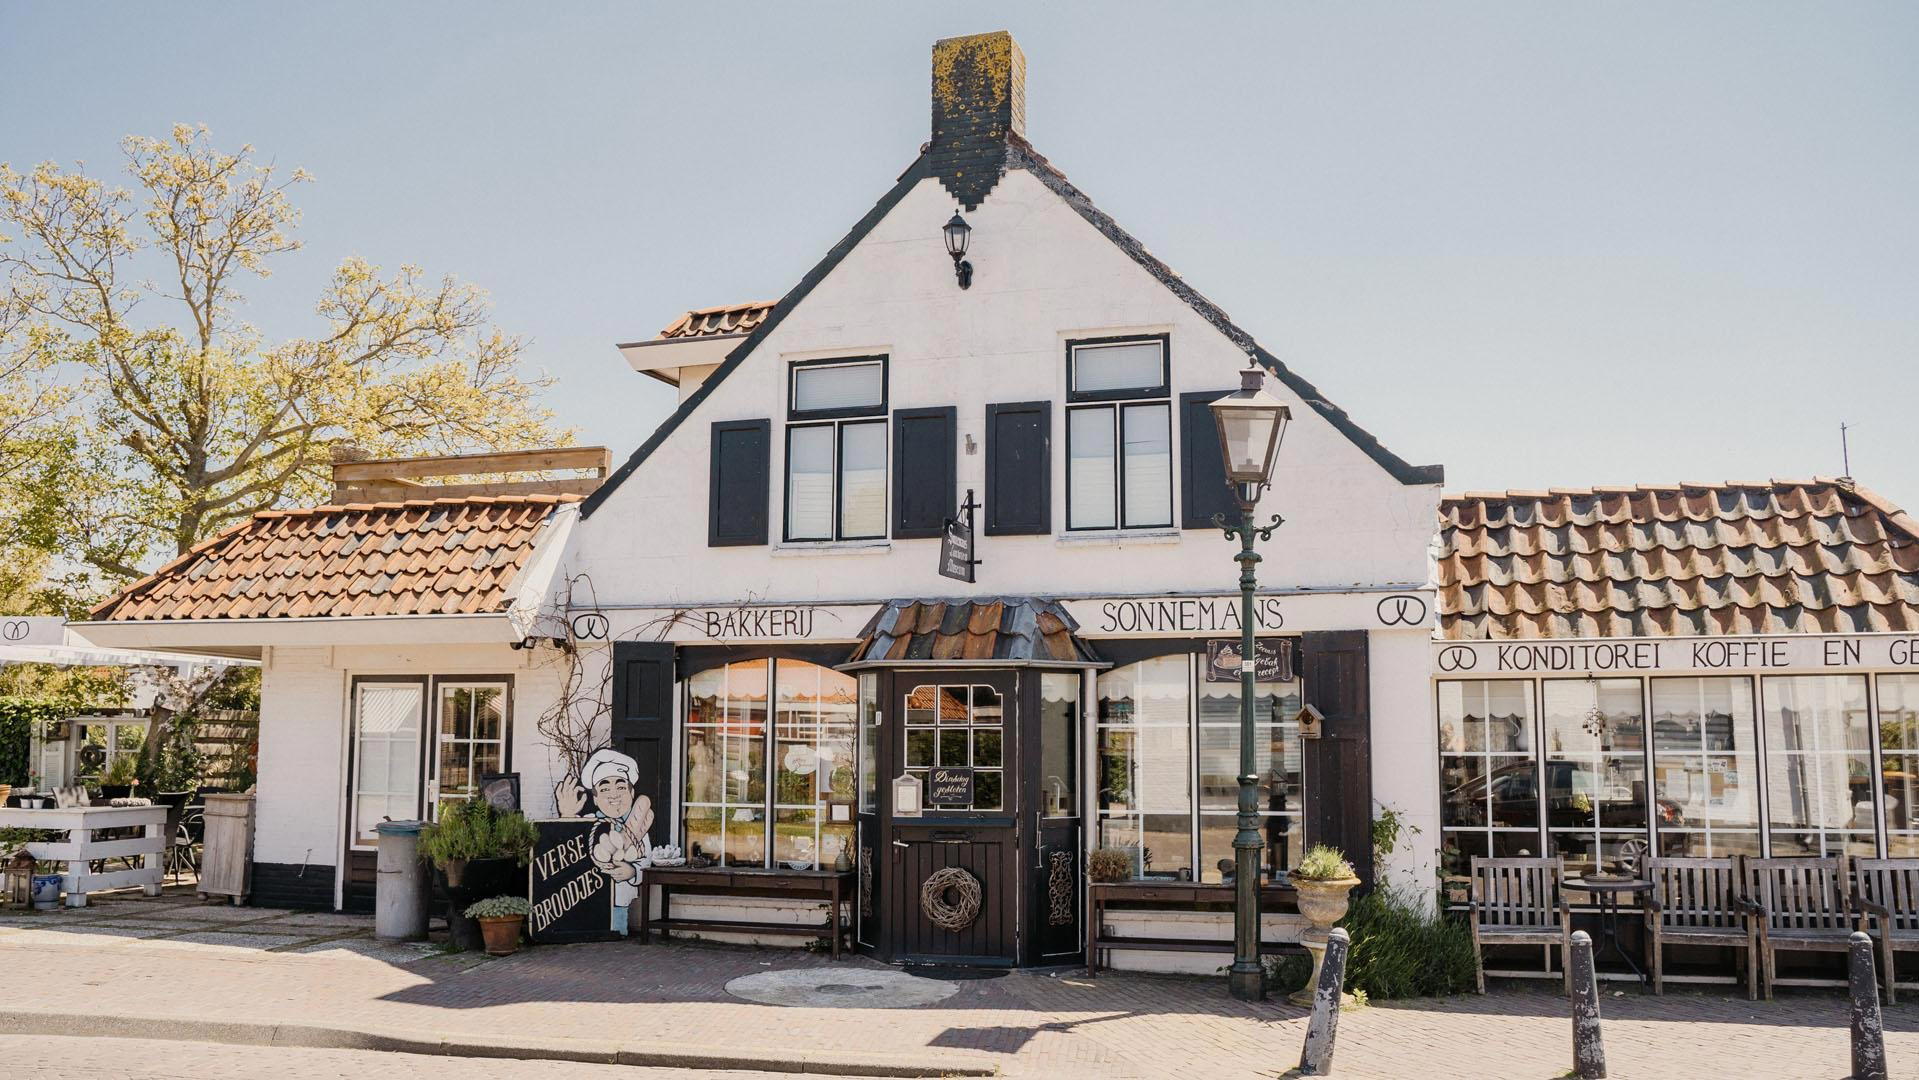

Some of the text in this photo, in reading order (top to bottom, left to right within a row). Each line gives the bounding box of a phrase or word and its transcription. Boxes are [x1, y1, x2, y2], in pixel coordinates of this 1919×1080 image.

[705, 598, 1284, 638] BAKKERIJ SONNEMANS
[1497, 643, 1660, 670] KONDITOREI
[1692, 641, 1789, 667] KOFFIE
[1824, 639, 1861, 666] EN
[535, 834, 587, 881] VERSE
[533, 866, 604, 932] BROODJES
